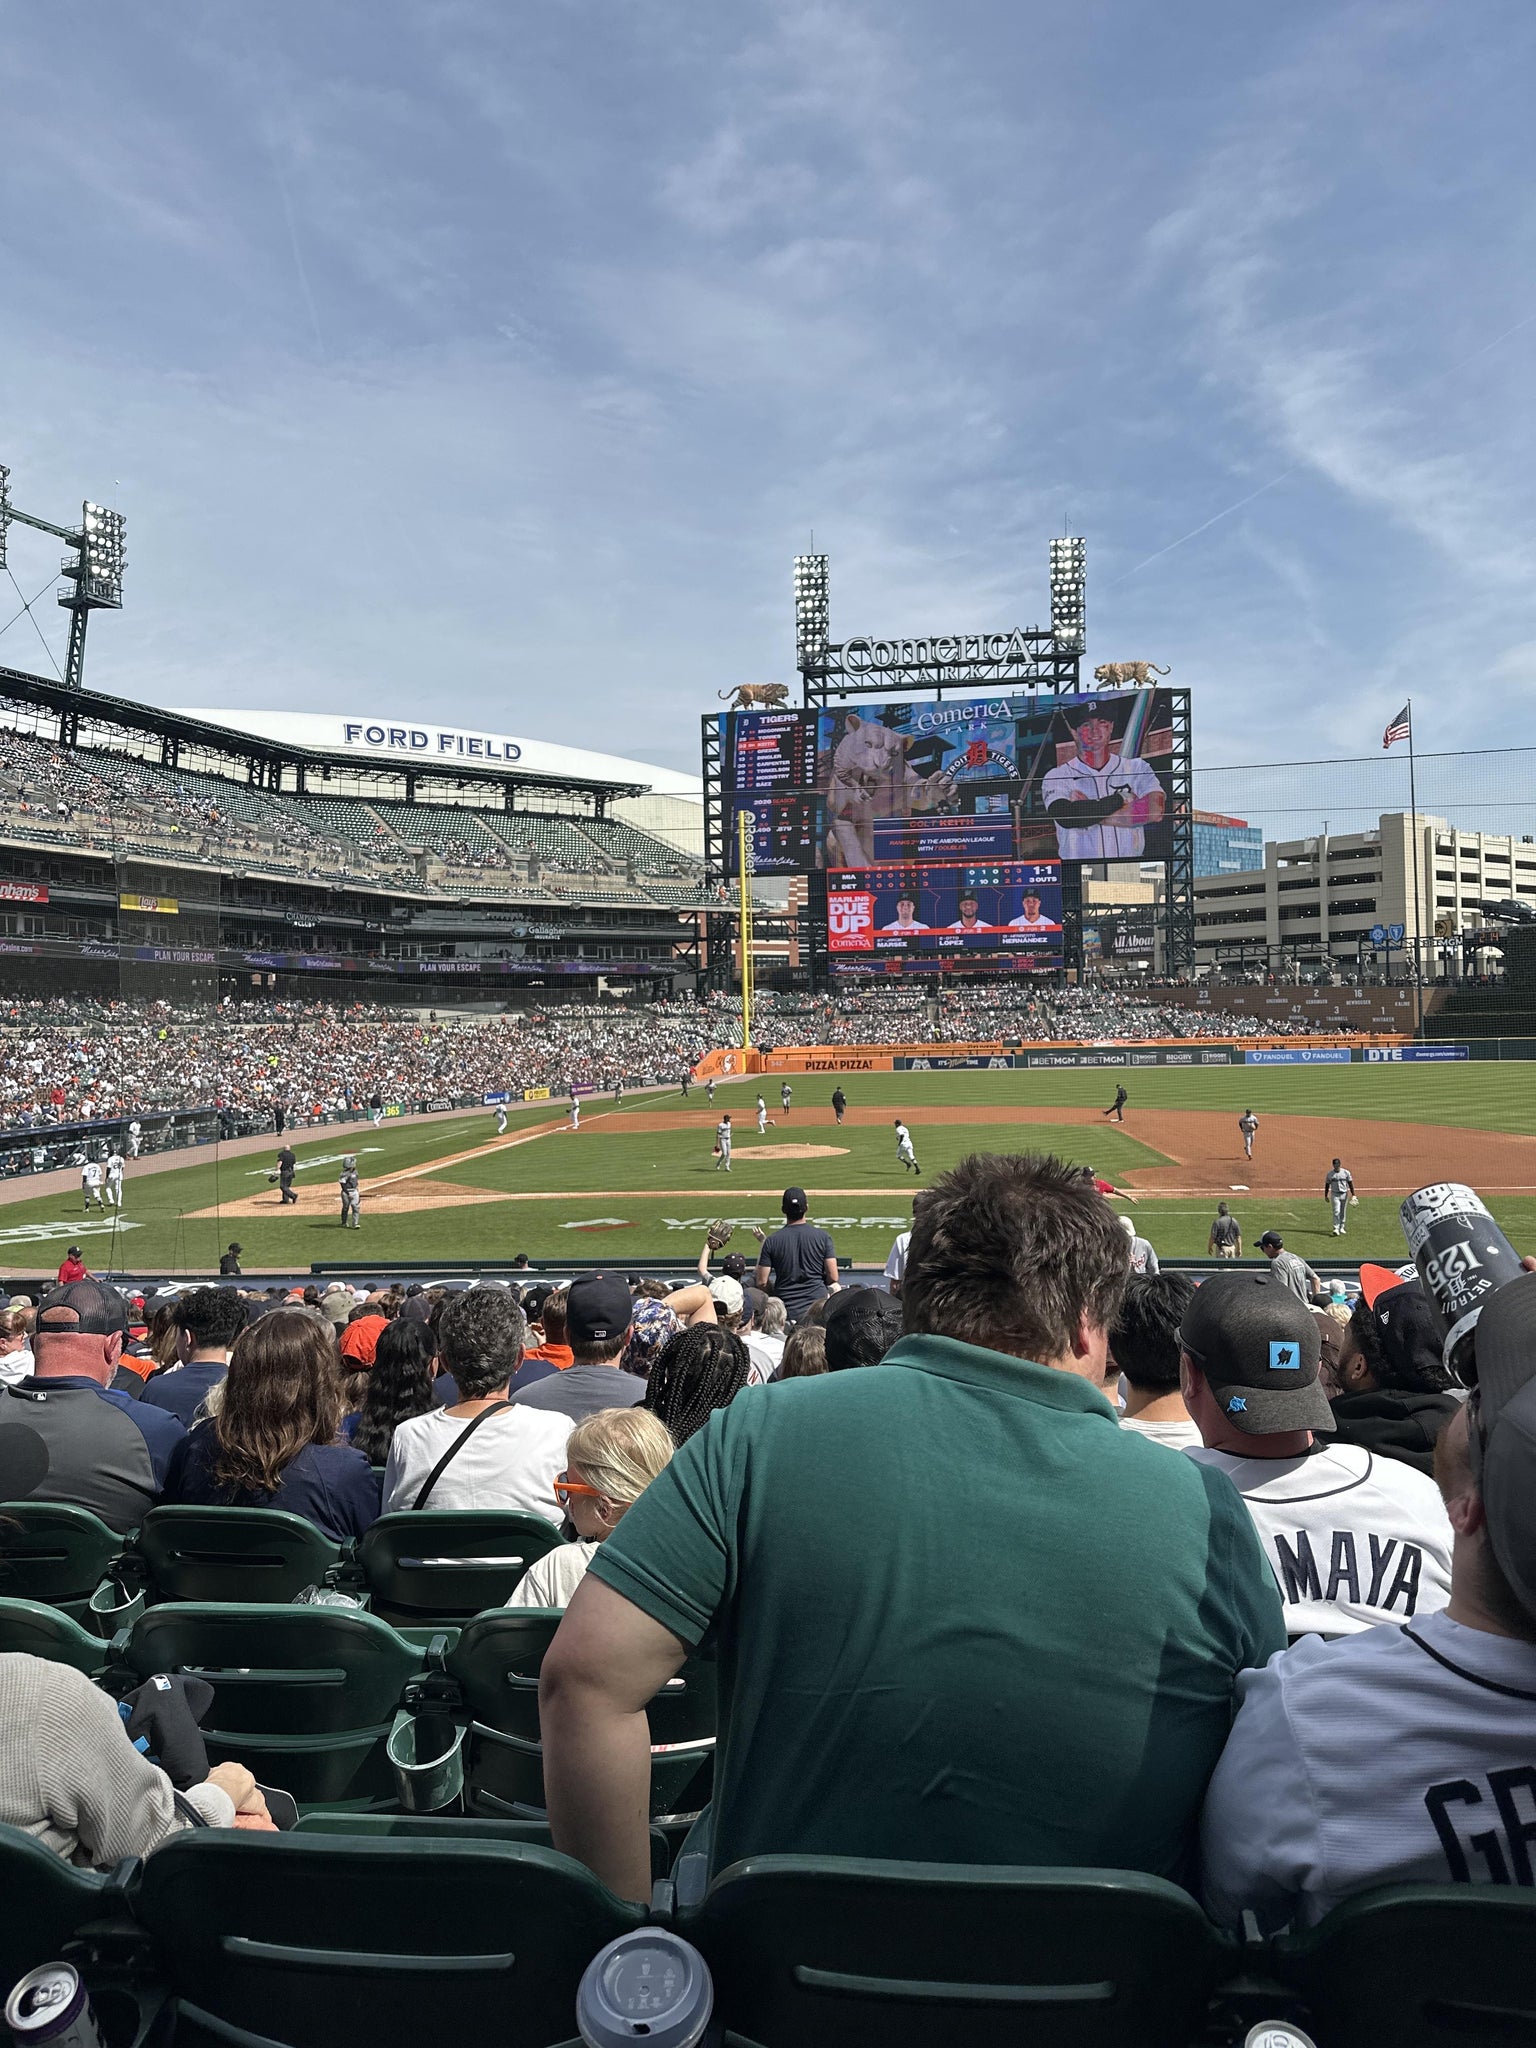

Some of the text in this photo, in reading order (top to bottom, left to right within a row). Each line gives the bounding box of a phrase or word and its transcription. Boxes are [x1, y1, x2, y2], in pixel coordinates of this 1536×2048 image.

[893, 664, 985, 684] PARK
[759, 714, 799, 724] TIGERS
[945, 721, 987, 735] PARK
[344, 723, 522, 762] FORD FIELD
[991, 752, 1018, 778] TIGERS
[909, 818, 976, 828] COLT KEITH
[745, 825, 757, 875] Rocket
[1033, 865, 1052, 875] 1-1
[829, 902, 870, 915] DUE
[285, 912, 322, 924] CHAMPIONS
[829, 915, 871, 934] UP
[528, 926, 566, 936] Gallagher
[1002, 936, 1048, 945] HERNÁNDEZ
[1112, 935, 1125, 949] All
[154, 950, 216, 963] PLAN YOUR ESCAPE
[420, 963, 481, 972] PLAN YOUR ESCAPE
[1198, 990, 1209, 999] 23
[1274, 988, 1280, 997] 5
[1313, 989, 1320, 998] 2
[1354, 989, 1363, 998] 16
[1399, 990, 1405, 999] 6
[1291, 1005, 1302, 1013] 47
[1334, 1006, 1340, 1014] 3
[1381, 1006, 1385, 1015] 1
[1368, 1049, 1403, 1061] DTE
[805, 1060, 873, 1070] PIZZA! PIZZA!
[1039, 1056, 1124, 1065] BETMGM BETMGM
[92, 1169, 97, 1178] 7
[1426, 1240, 1484, 1296] 125
[1441, 1278, 1493, 1314] DETROIT
[1274, 1530, 1423, 1617] MAYA
